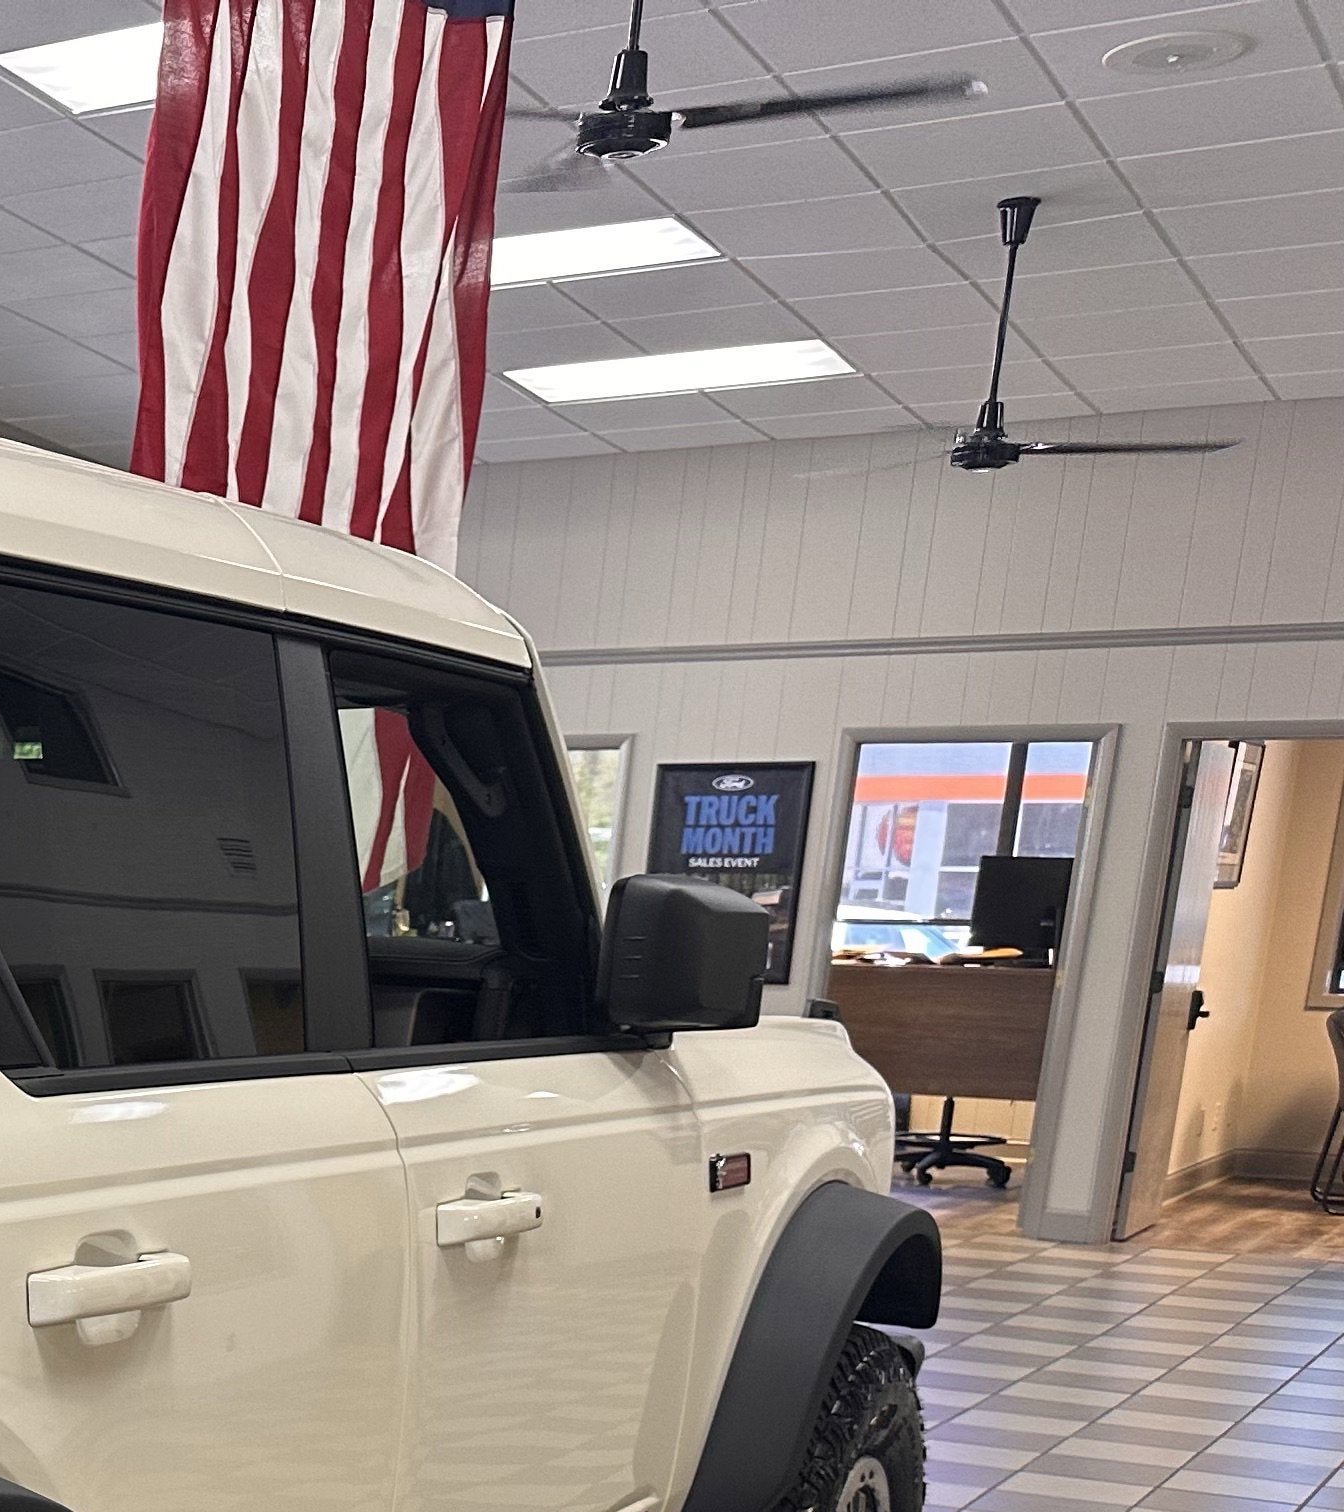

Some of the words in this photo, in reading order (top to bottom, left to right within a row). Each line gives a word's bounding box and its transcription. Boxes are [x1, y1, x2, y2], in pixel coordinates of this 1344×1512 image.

[684, 794, 779, 826] TRUCK
[681, 826, 776, 855] MONTH
[688, 857, 723, 868] SALES
[724, 857, 760, 868] EVENT
